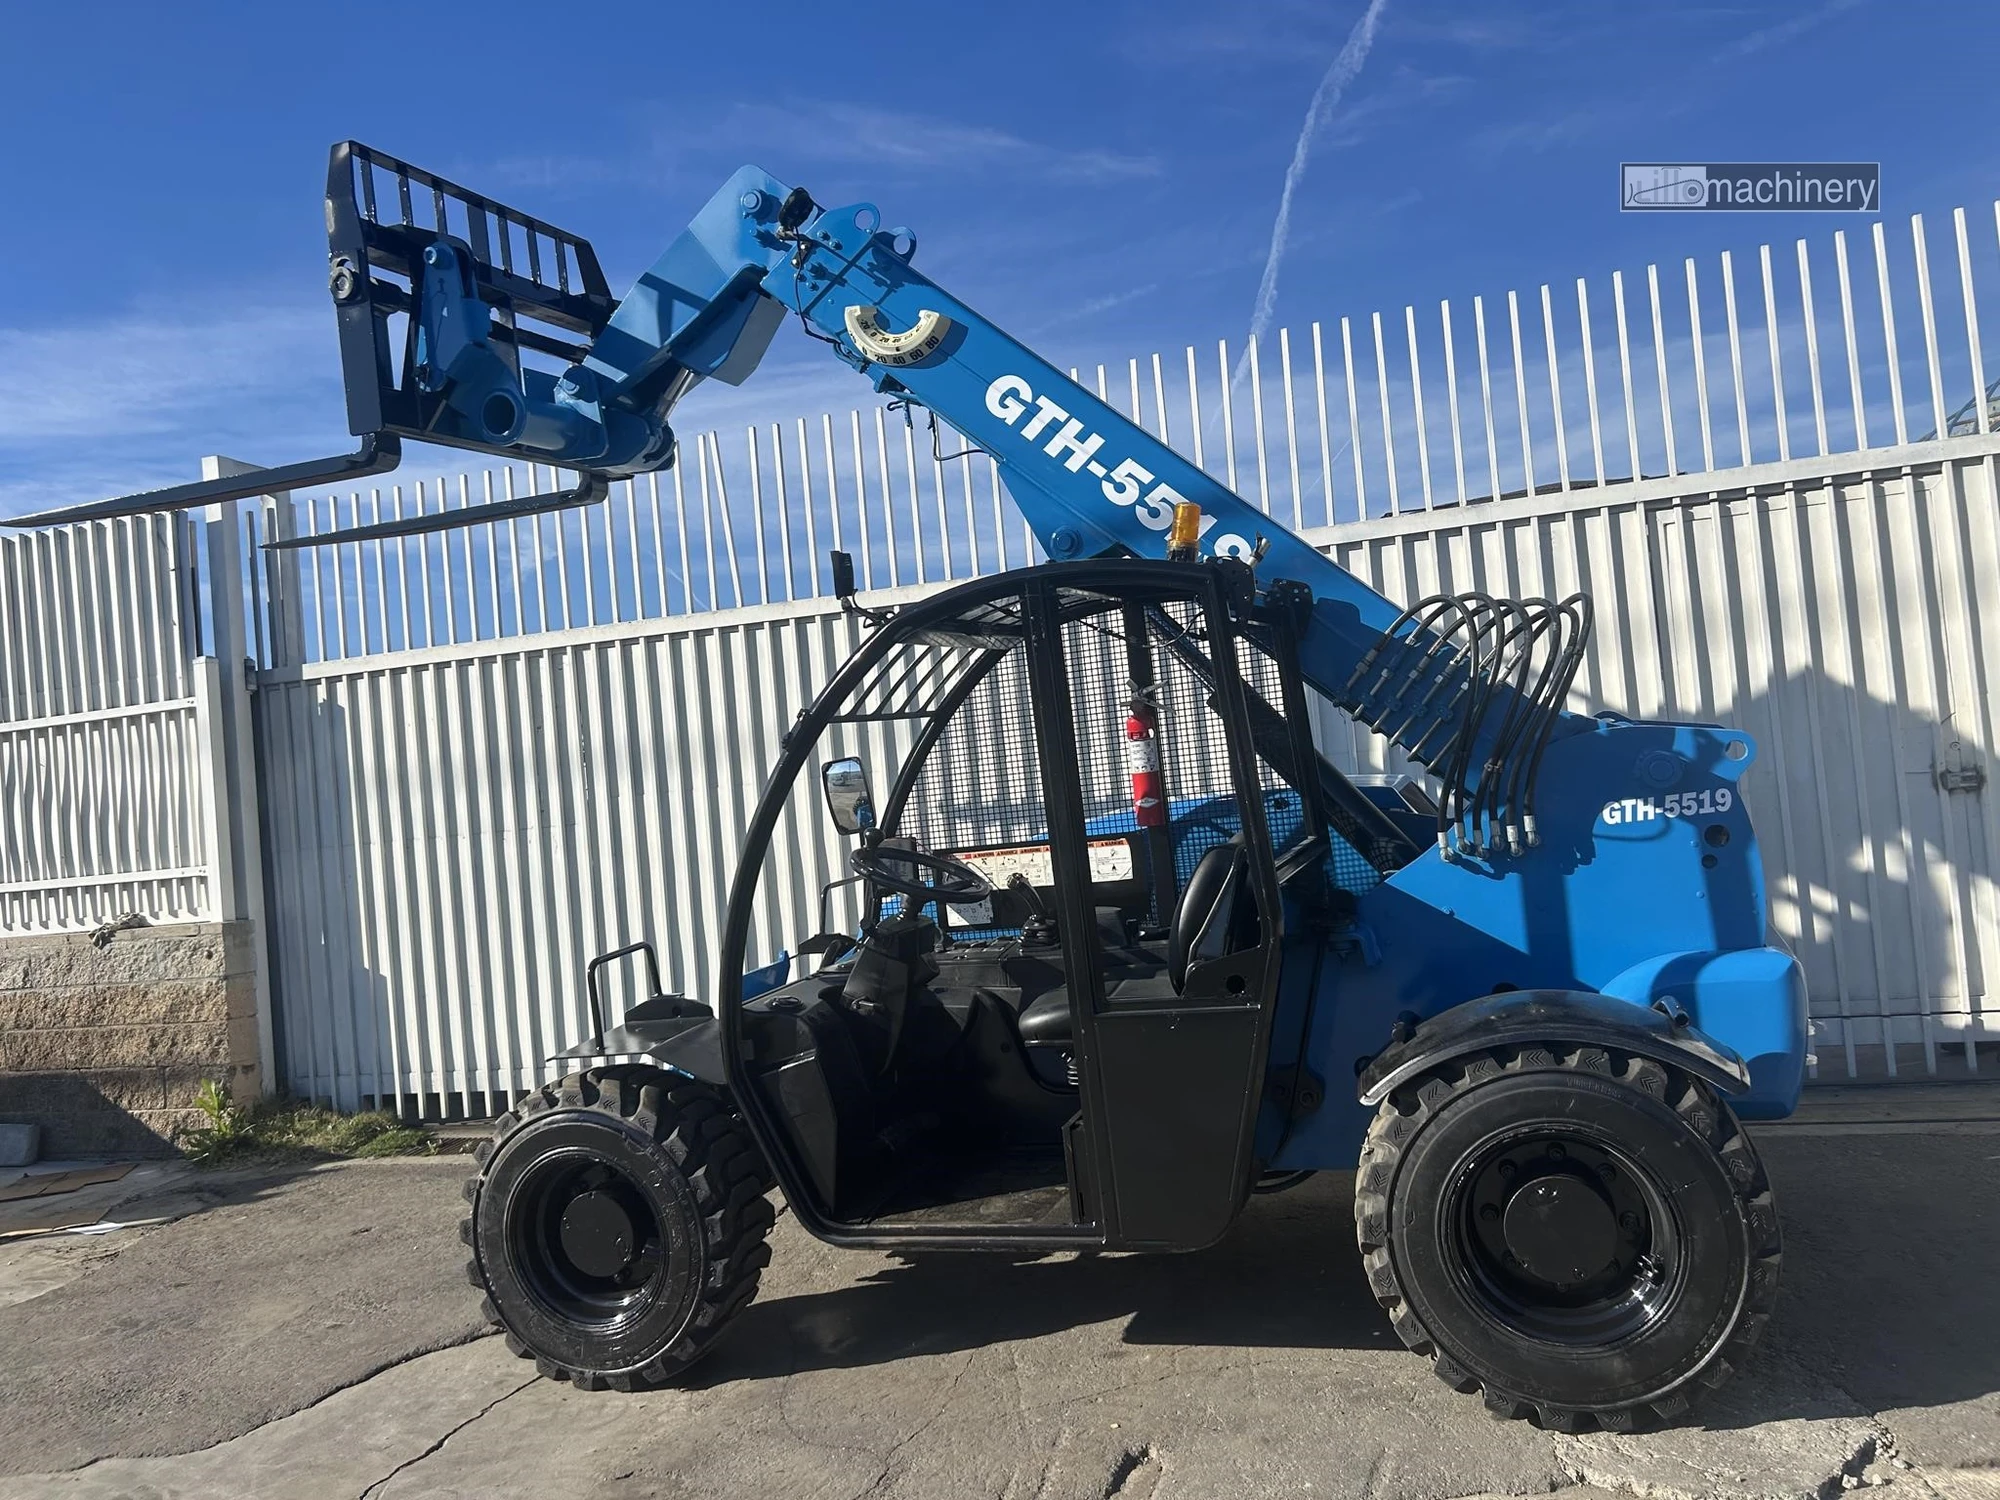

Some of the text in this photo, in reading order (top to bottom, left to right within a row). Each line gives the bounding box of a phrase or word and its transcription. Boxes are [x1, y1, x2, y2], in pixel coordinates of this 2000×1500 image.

[893, 356, 906, 364] 40
[910, 349, 924, 360] 60
[925, 336, 939, 349] 80
[1602, 787, 1732, 825] GTH-5519
